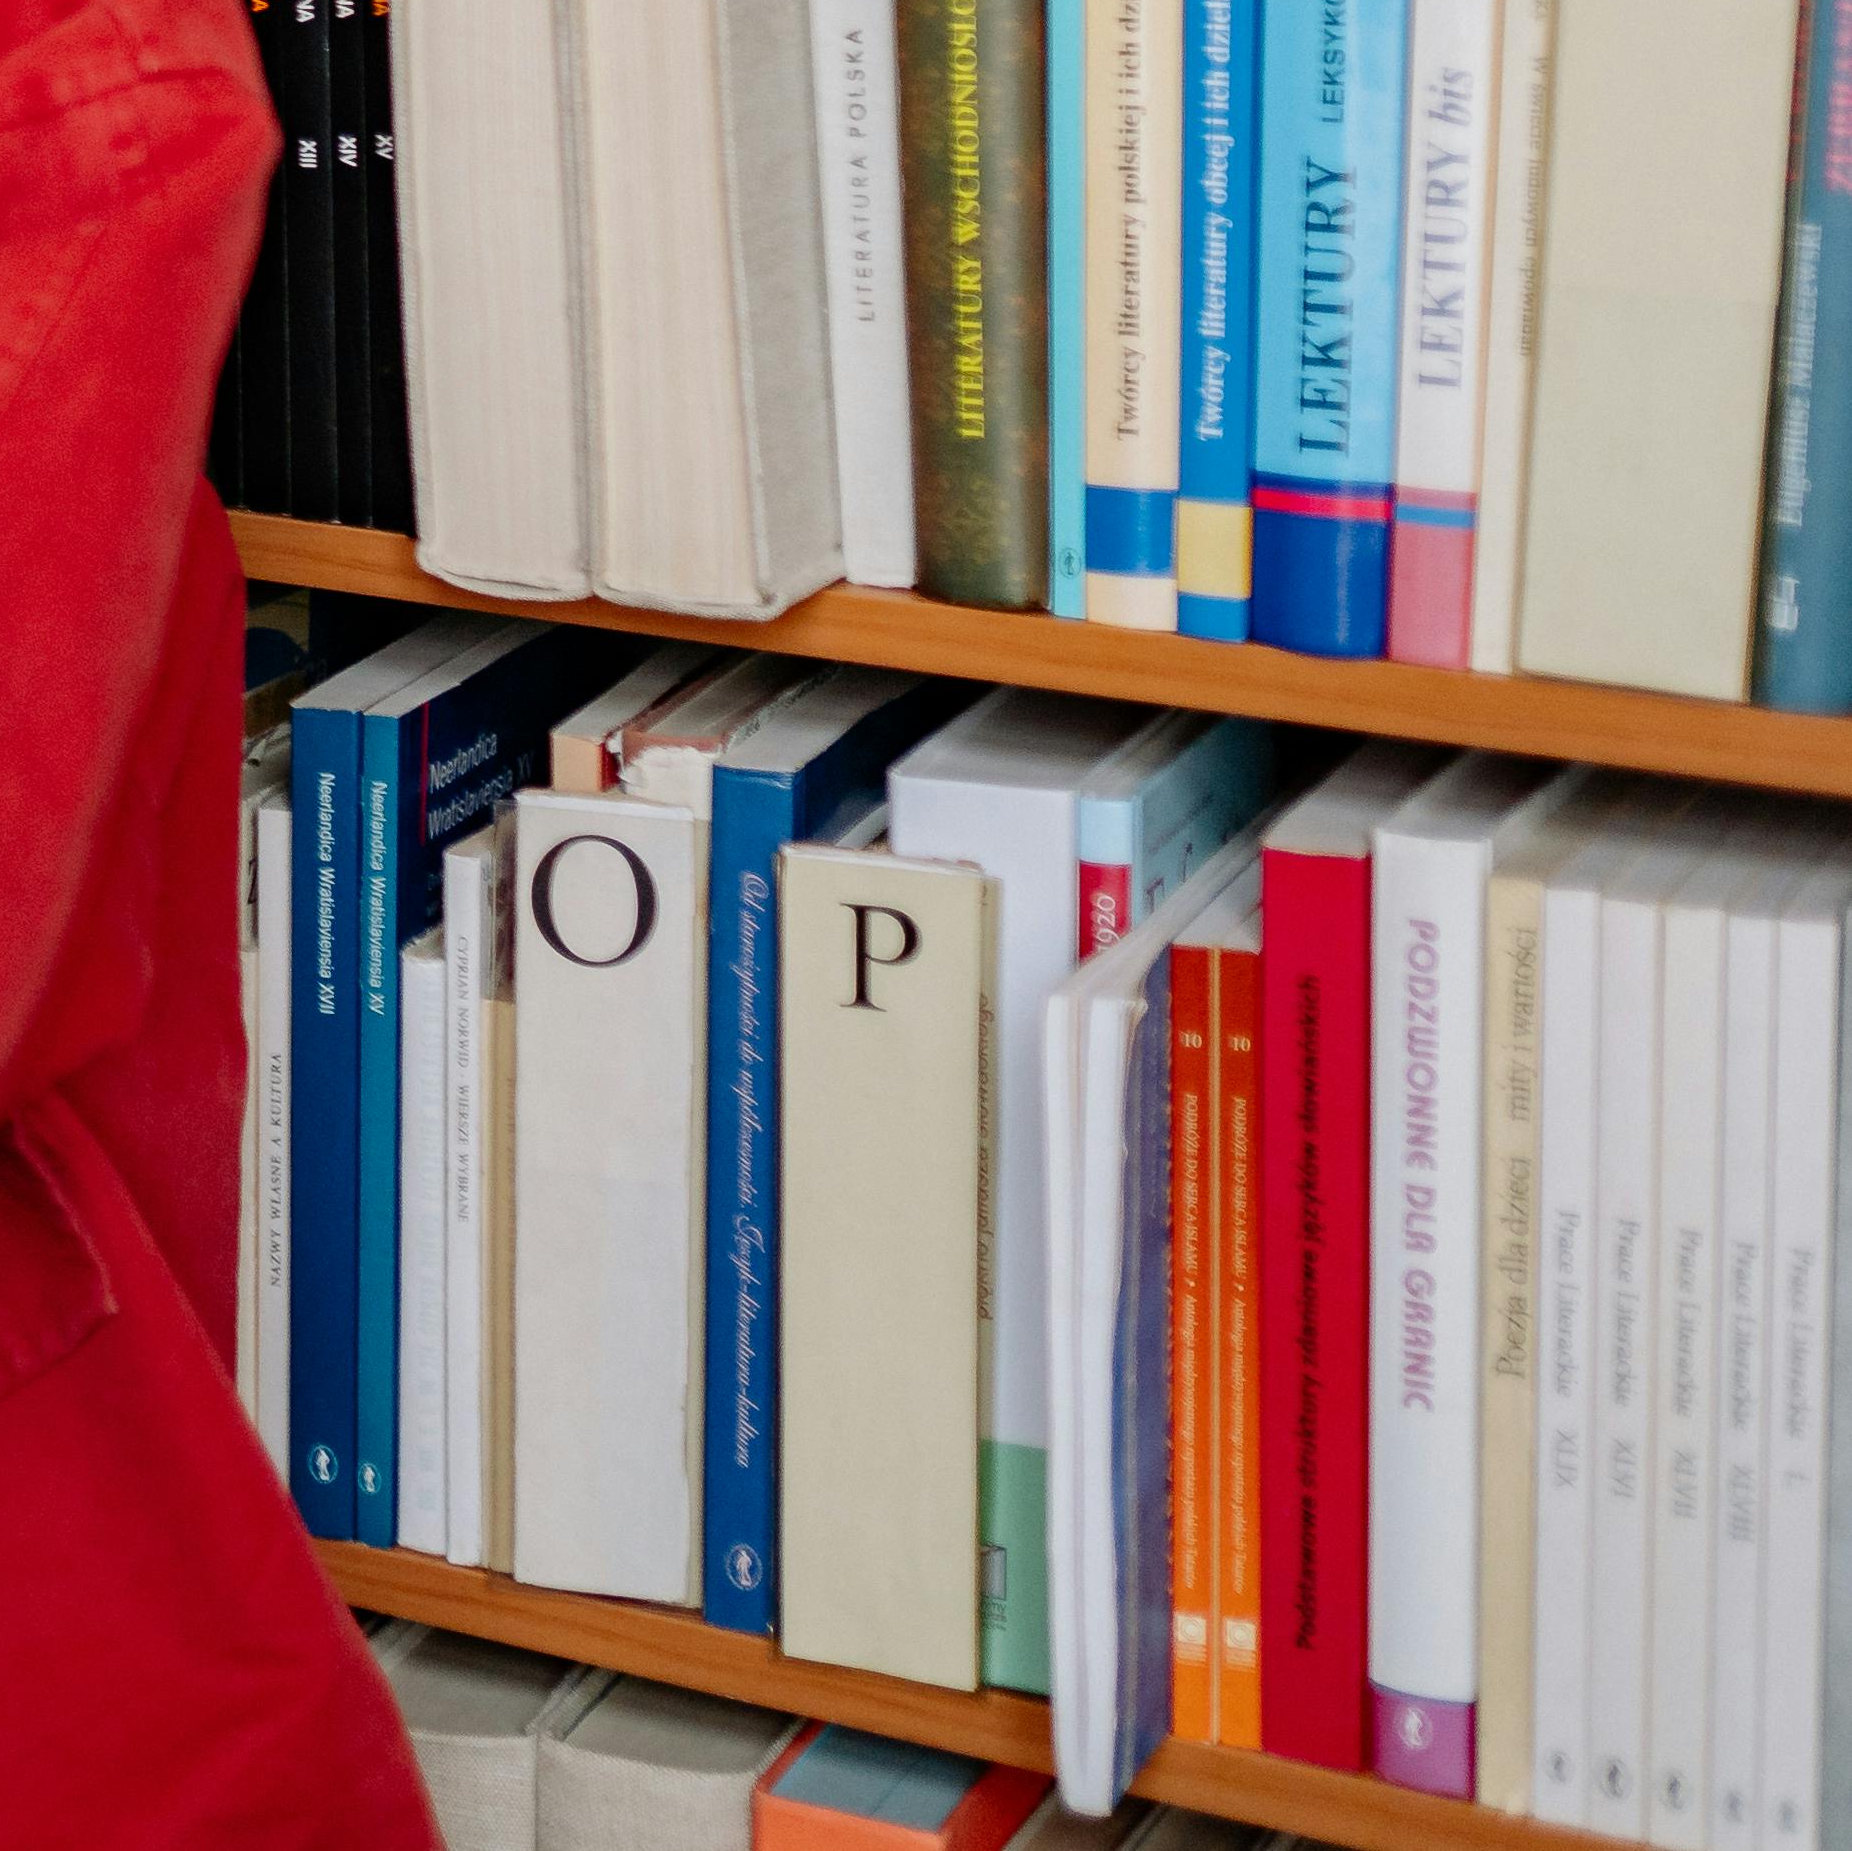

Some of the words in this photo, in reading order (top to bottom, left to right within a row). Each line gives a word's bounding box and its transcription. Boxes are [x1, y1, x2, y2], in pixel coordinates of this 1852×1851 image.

[845, 30, 867, 138] POLSKA
[1118, 43, 1139, 79] ich
[1201, 71, 1229, 111] ich
[1427, 68, 1473, 128] bis
[299, 139, 317, 168] XIII
[338, 135, 357, 167] XIV
[375, 134, 393, 160] XV
[1118, 104, 1146, 203] polskiej
[1201, 133, 1235, 204] obcej
[850, 156, 875, 322] LITERATURA
[1117, 213, 1144, 337] literatury
[1198, 212, 1233, 338] literatury
[1419, 142, 1470, 388] LEKTURY
[951, 255, 985, 440] LITERATURY
[1299, 156, 1356, 458] LEKTURY
[1114, 347, 1145, 441] Twórcy
[1194, 346, 1230, 441] Twórcy
[428, 768, 513, 839] Wratislaviensia
[429, 733, 497, 793] Neerlandica
[318, 772, 335, 861] Neerlandica
[370, 781, 387, 870] Neerlandica
[318, 867, 335, 978] Wratislaviensia
[370, 876, 387, 987] Wratislaviensia
[531, 835, 659, 967] O
[458, 936, 469, 1001] CYPRIAN
[838, 902, 923, 1011] P
[1506, 928, 1536, 1037] wartości
[319, 982, 335, 1014] XVII
[370, 993, 385, 1015] XV
[458, 1008, 469, 1068] NORWID
[1405, 919, 1440, 1170] PODZWONNE
[270, 1052, 282, 1127] KULTURA
[458, 1085, 469, 1144] WIERSZE
[1503, 1059, 1536, 1120] mity
[271, 1137, 282, 1147] A
[270, 1155, 282, 1219] WŁASNE
[458, 1153, 469, 1223] WYBRANE
[1299, 1142, 1325, 1244] języków
[1405, 1184, 1437, 1254] DLA
[1498, 1157, 1529, 1236] dzieci
[270, 1227, 282, 1287] NAZWY
[1497, 1243, 1528, 1284] dla
[1558, 1211, 1582, 1274] Prace
[1297, 1251, 1316, 1365] zdaniowe
[1402, 1269, 1436, 1412] GRANIC
[1494, 1296, 1529, 1379] Poezja
[1298, 1376, 1322, 1487] struktury
[1295, 1494, 1315, 1647] Podstawowe
